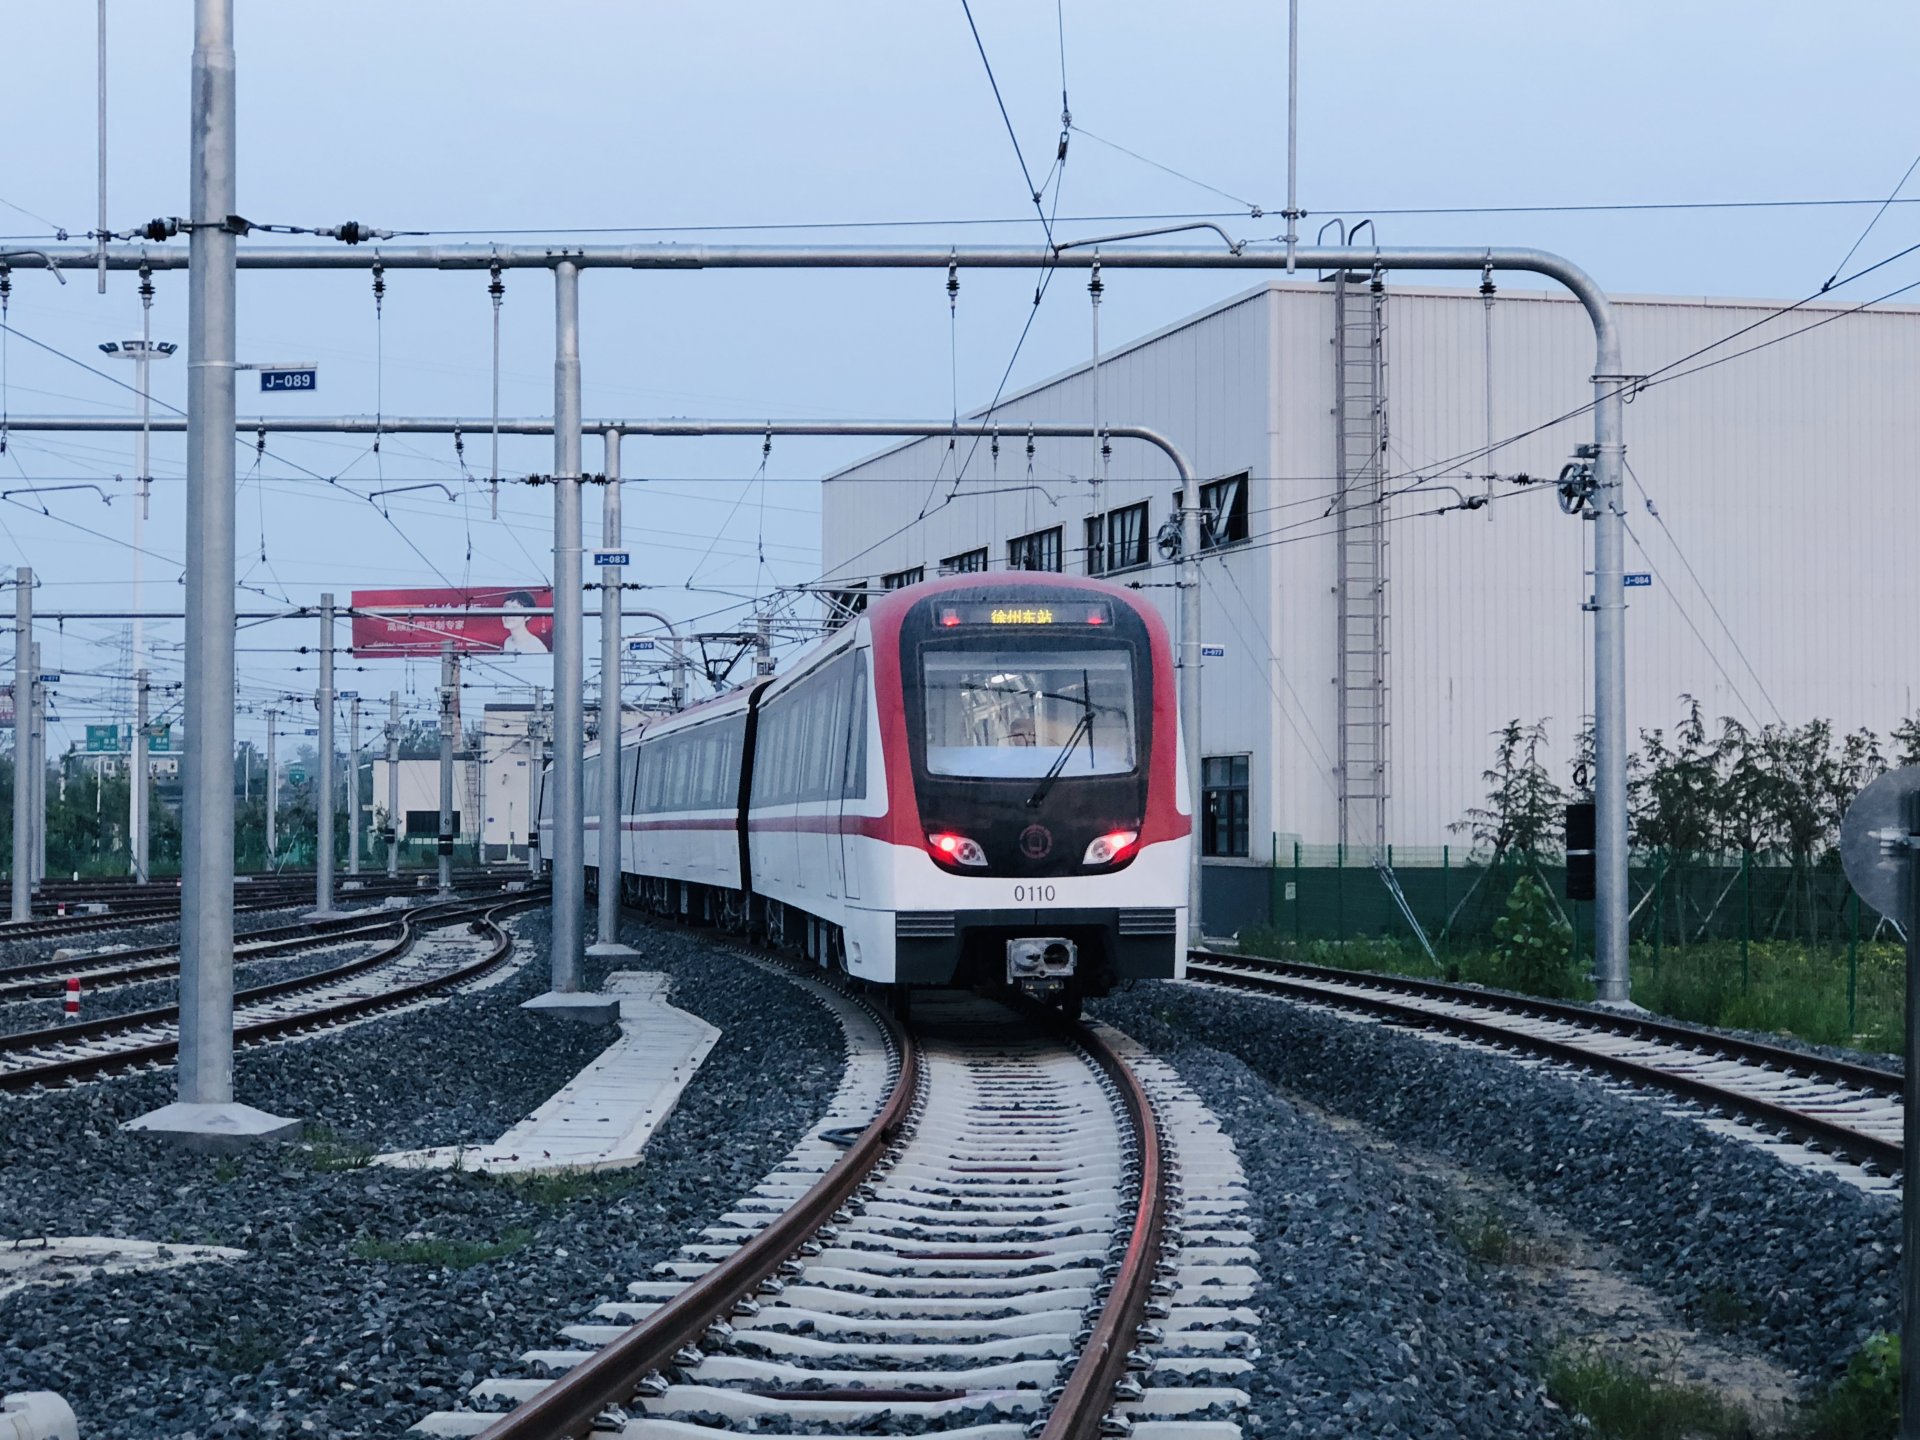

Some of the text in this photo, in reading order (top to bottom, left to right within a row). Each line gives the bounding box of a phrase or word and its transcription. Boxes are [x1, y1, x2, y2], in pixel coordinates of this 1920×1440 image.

[266, 374, 310, 388] J-089
[597, 555, 626, 564] J-083
[991, 609, 1053, 624] 徐州东站
[1014, 885, 1055, 901] 0110
